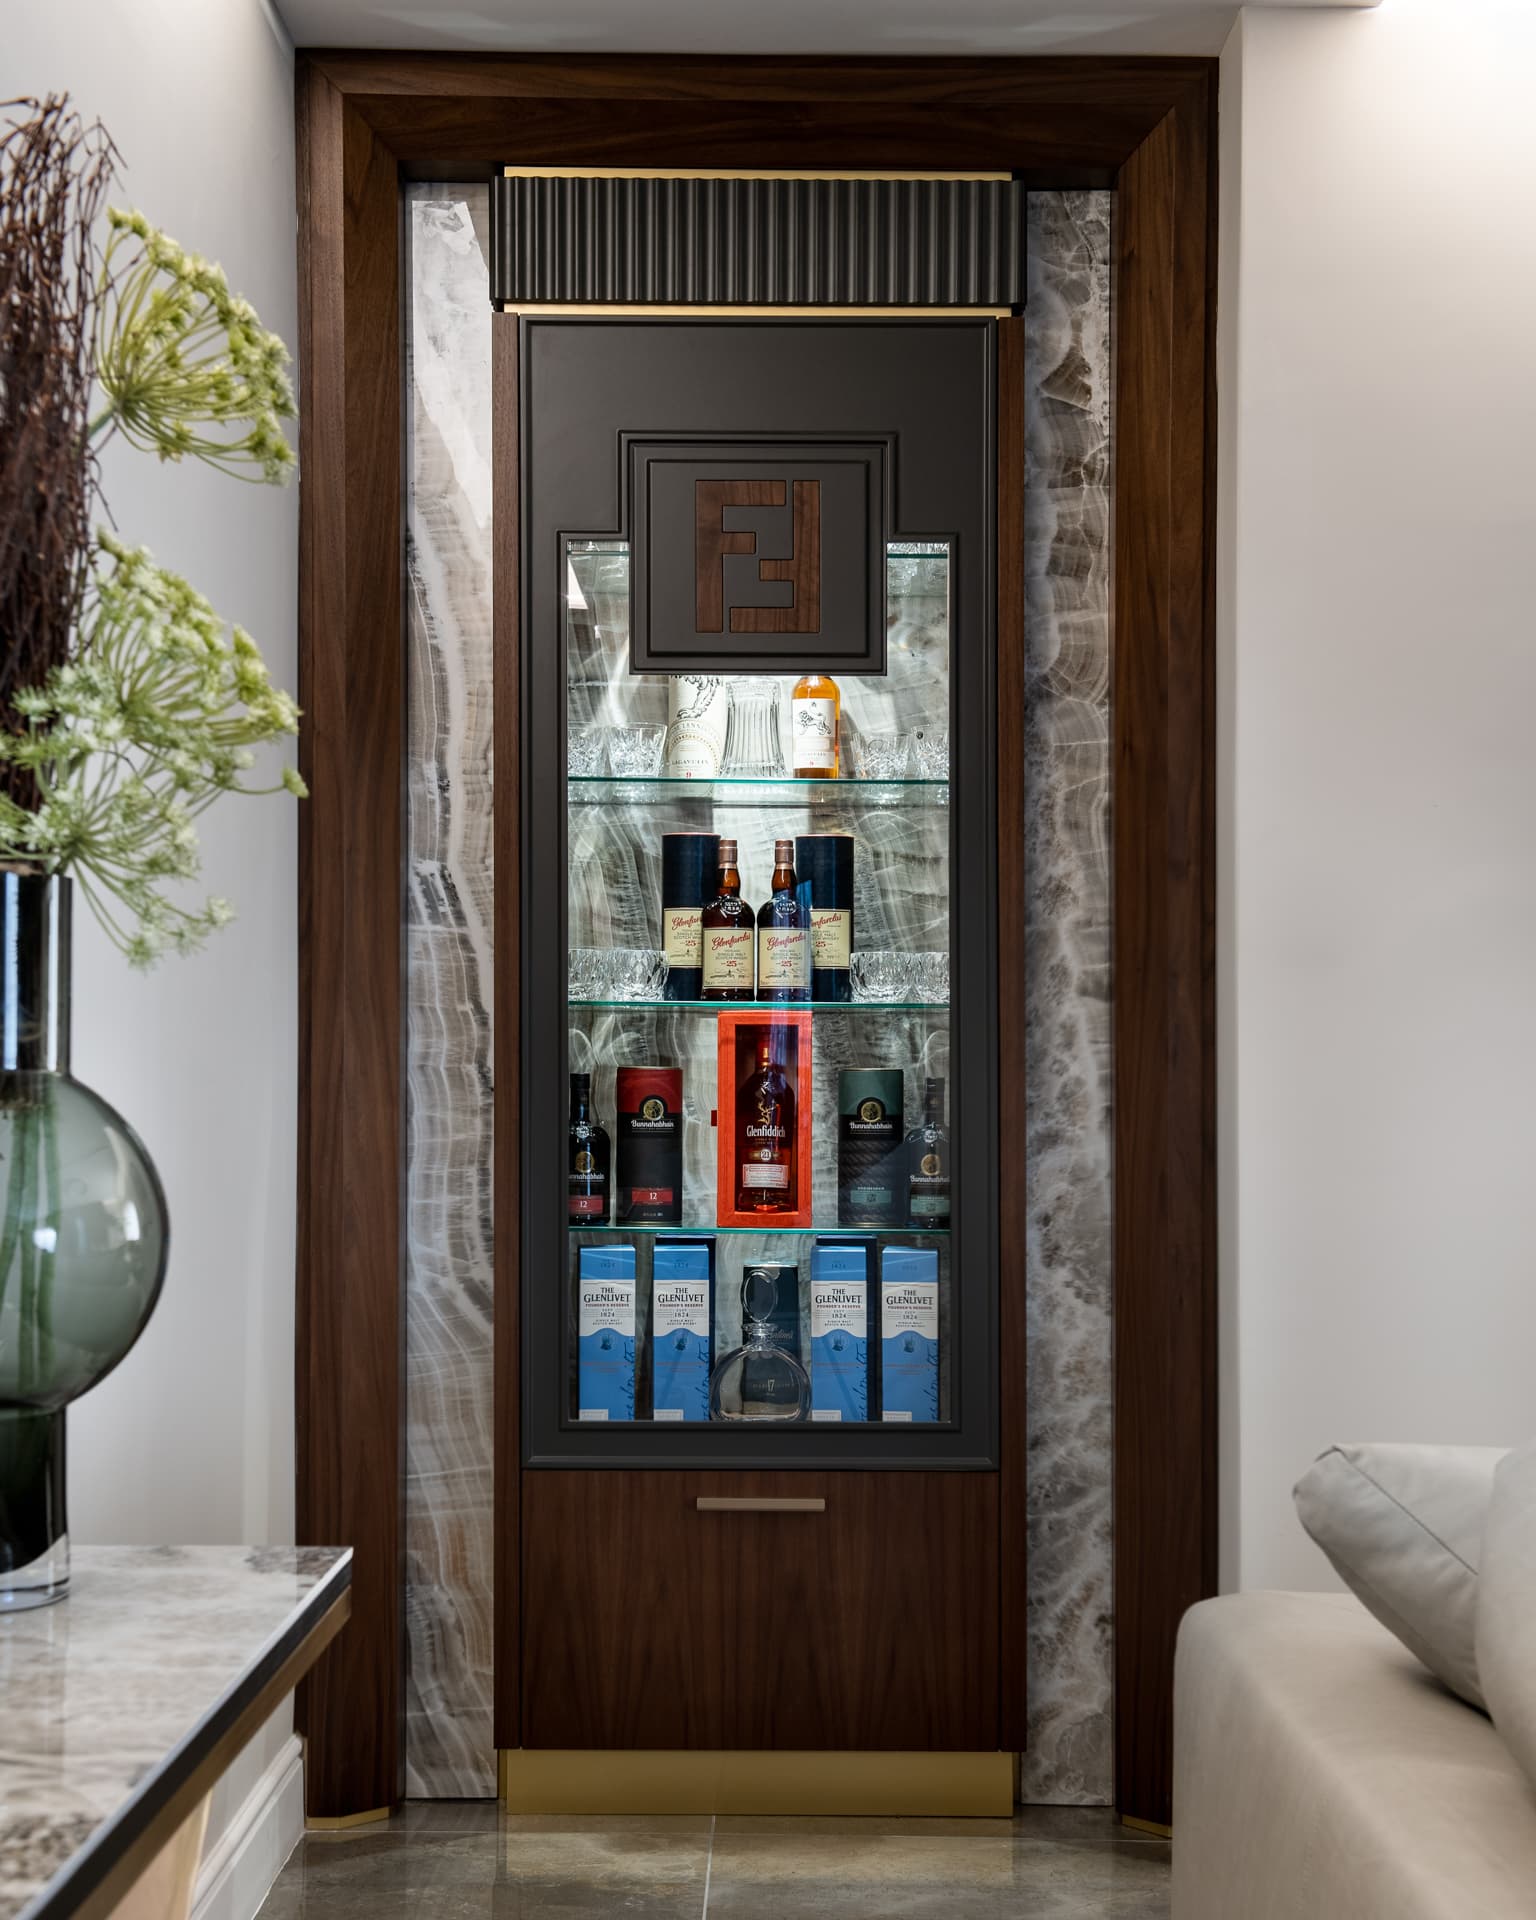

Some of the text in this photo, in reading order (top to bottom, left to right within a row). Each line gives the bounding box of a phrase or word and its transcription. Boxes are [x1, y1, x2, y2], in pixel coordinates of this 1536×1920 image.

[746, 1124, 786, 1137] Glenfiddich
[649, 1192, 658, 1200] 12
[580, 1200, 588, 1208] 12
[583, 1293, 632, 1303] GLENLIVET
[657, 1293, 705, 1303] GLENLIVET
[815, 1294, 863, 1304] GLENLIVET
[886, 1296, 934, 1305] GLENLIVET
